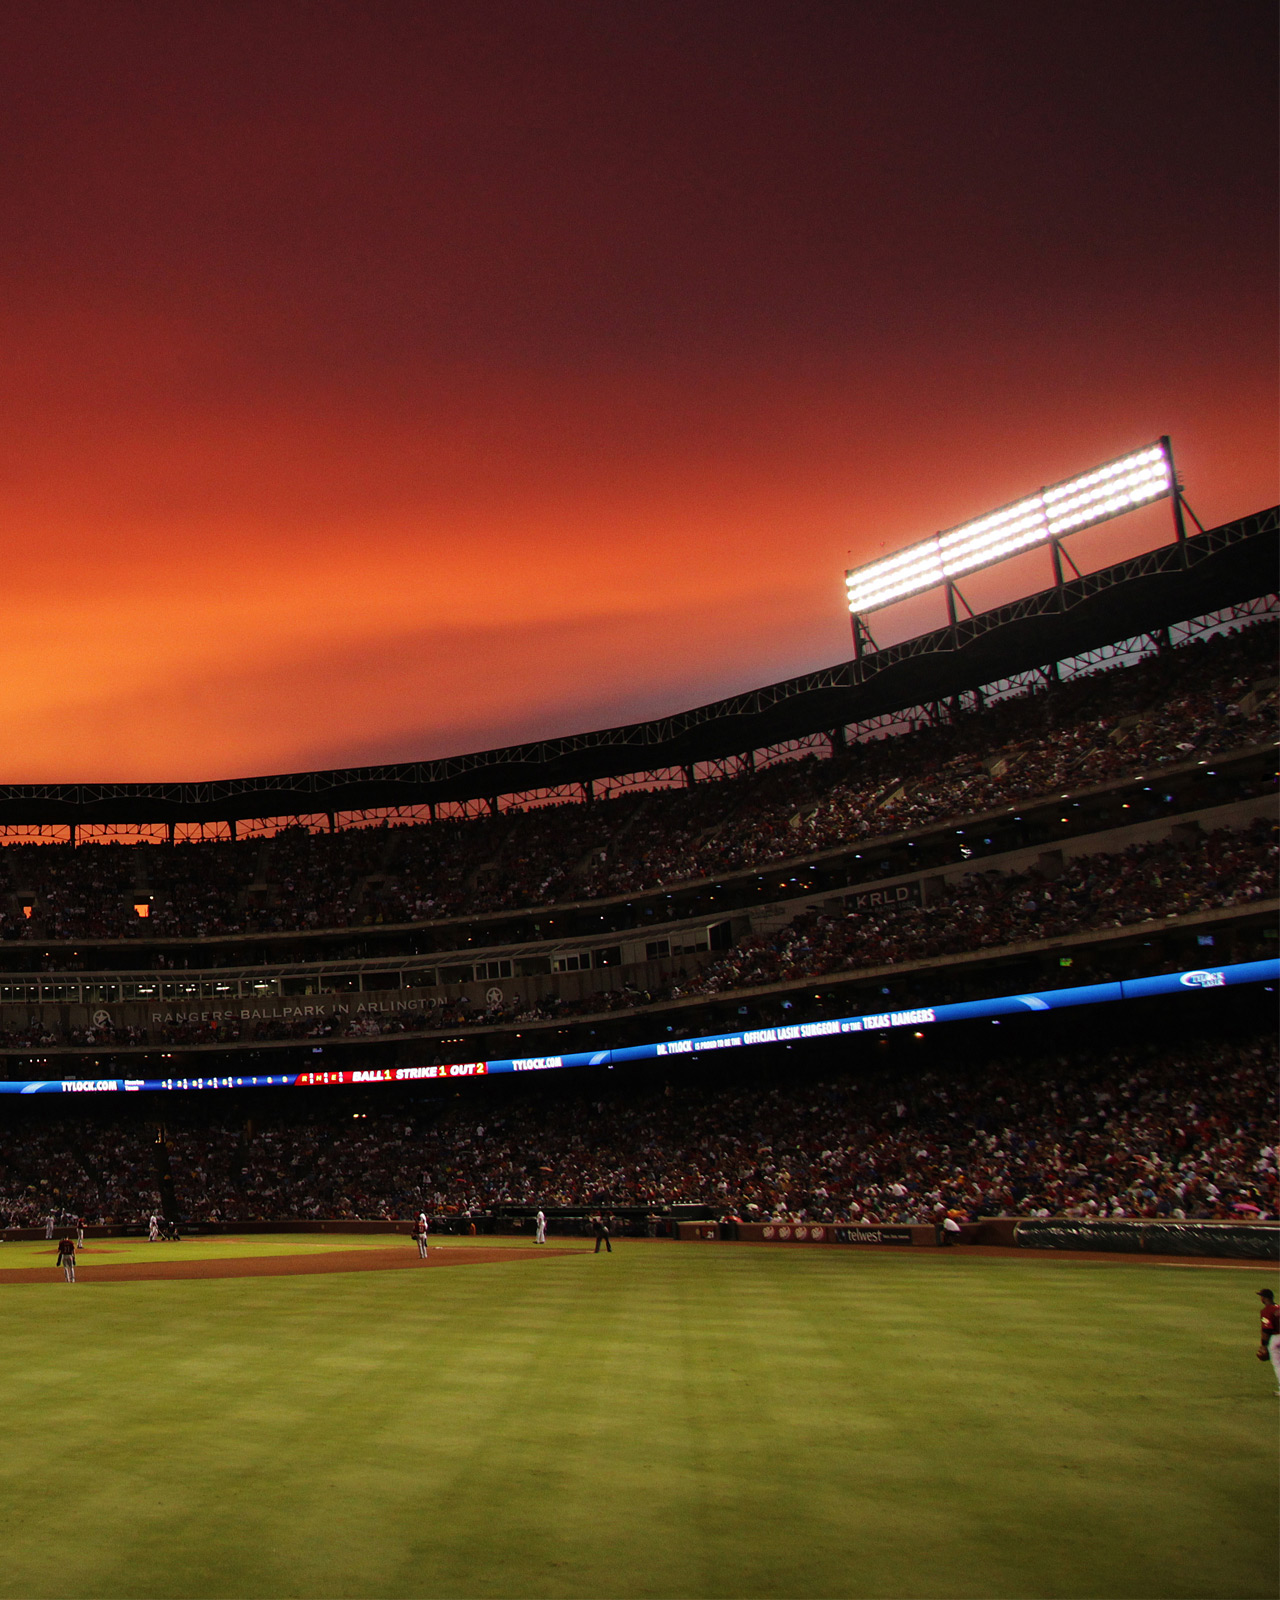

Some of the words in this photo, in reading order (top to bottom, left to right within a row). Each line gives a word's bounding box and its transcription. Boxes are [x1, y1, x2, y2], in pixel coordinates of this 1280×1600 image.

[856, 887, 909, 909] KRLD
[152, 1010, 233, 1023] RANGERS
[240, 1005, 325, 1020] BALLPARK
[333, 1003, 349, 1014] IN
[356, 997, 448, 1013] ARLINGTON
[668, 1040, 693, 1054] TYLOCK
[743, 1029, 777, 1044] OFFICIAL
[777, 1026, 801, 1040] LASIK
[800, 1021, 840, 1037] SURGEON
[862, 1014, 891, 1029] TEXAS
[890, 1008, 935, 1026] RANGERS
[352, 1070, 383, 1082] BALL
[384, 1069, 392, 1080] 1
[396, 1067, 438, 1079] STRIKE
[439, 1065, 447, 1076] 1
[450, 1064, 476, 1075] OUT
[476, 1062, 484, 1073] 2
[512, 1056, 563, 1071] TYLOCK.COM
[61, 1081, 117, 1091] TYLOCK.COM
[848, 1228, 882, 1242] telwest
